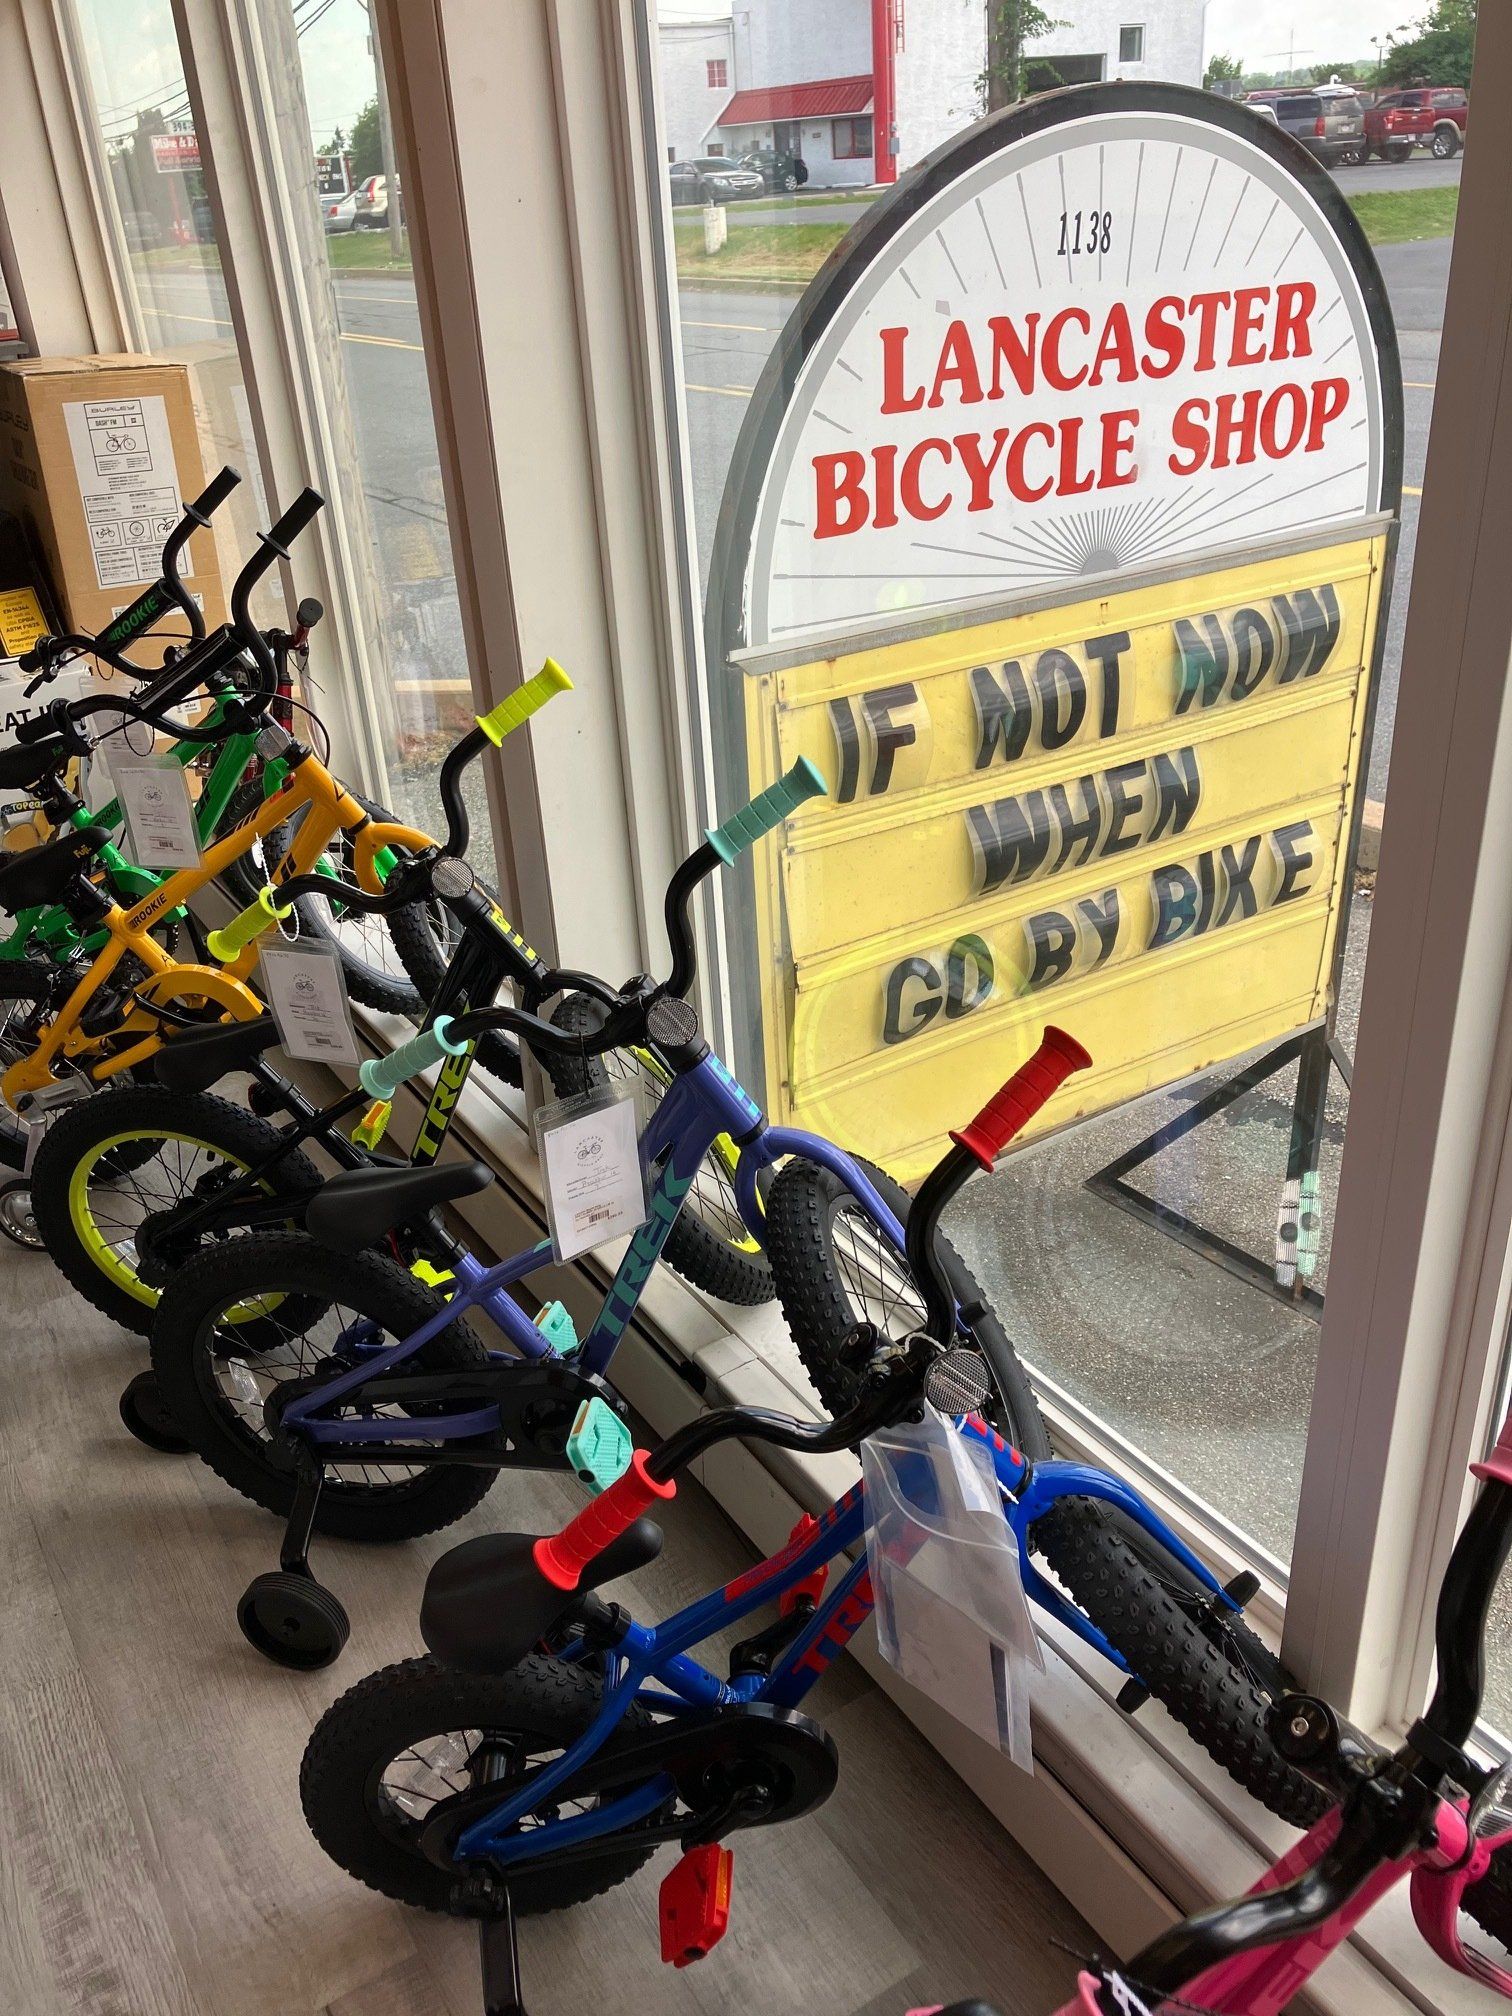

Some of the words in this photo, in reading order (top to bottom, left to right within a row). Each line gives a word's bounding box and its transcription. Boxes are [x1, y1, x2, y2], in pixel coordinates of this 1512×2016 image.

[1056, 210, 1112, 256] 1138
[880, 281, 1317, 415] LANCASTER
[811, 408, 1140, 540] BICYCLE
[1168, 376, 1350, 477] SHOP
[113, 595, 160, 641] ROOKIE
[828, 682, 918, 804] IF
[969, 630, 1131, 769] NOT
[1174, 583, 1341, 715] NOW
[967, 746, 1200, 894] WHEN
[133, 893, 167, 928] ROOKIE
[883, 933, 995, 1044] GO
[1028, 888, 1120, 989] BY
[1148, 819, 1315, 950] BIKE
[412, 1000, 476, 1158] TRE
[594, 1158, 692, 1338] TREK
